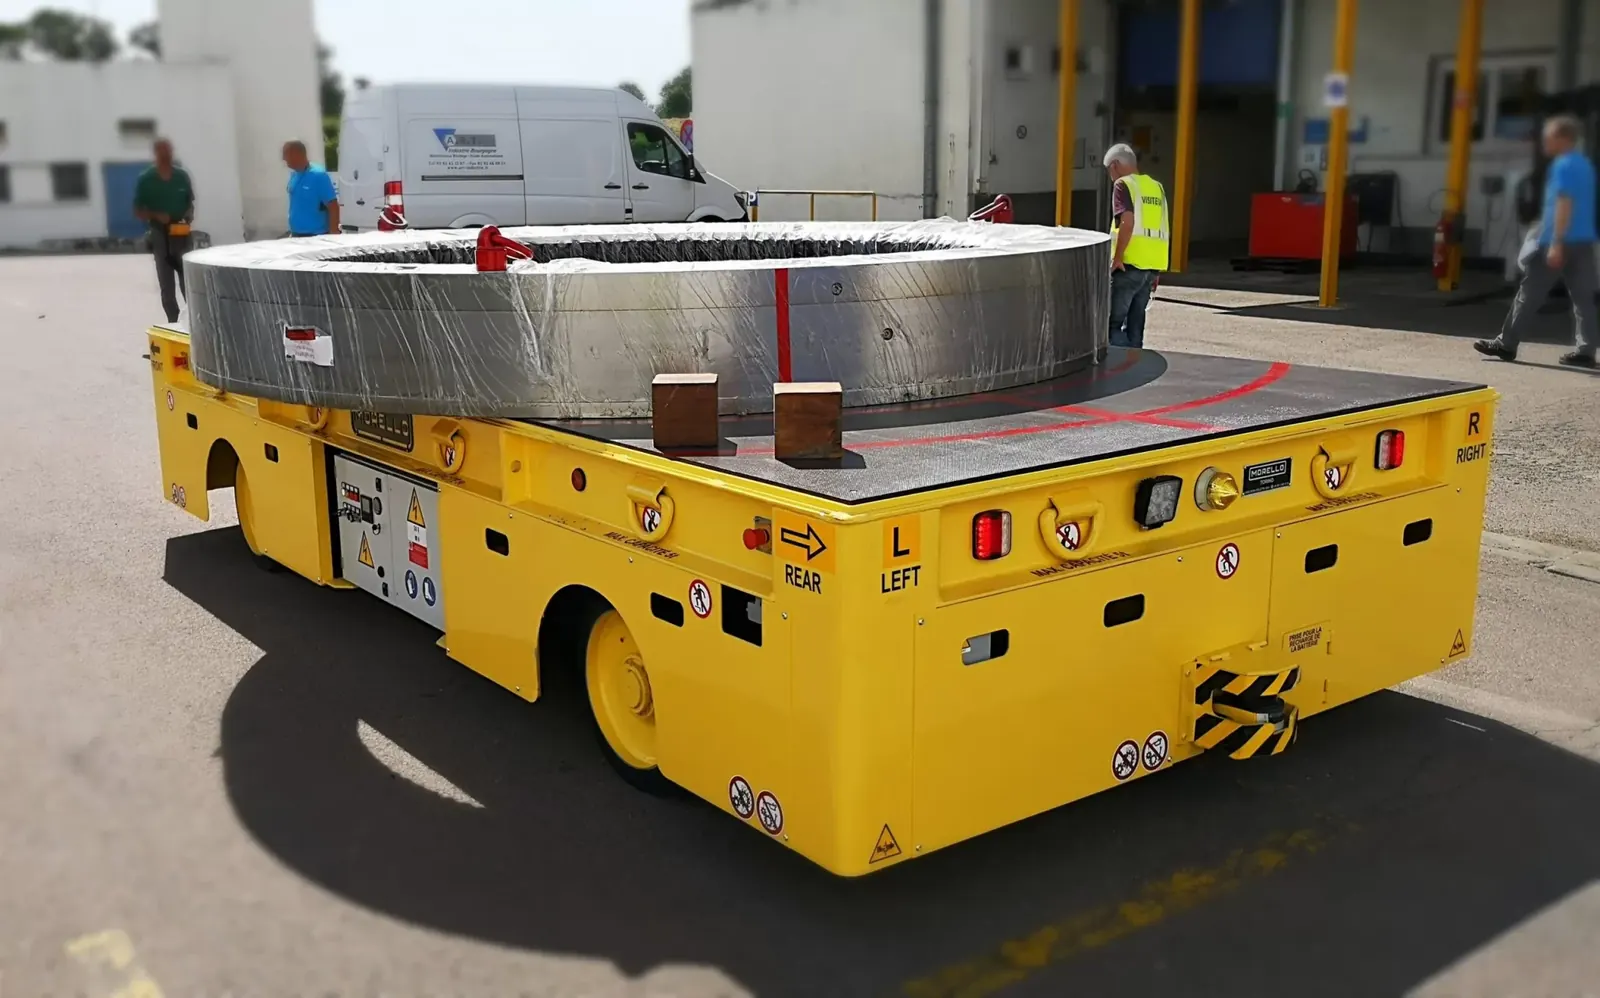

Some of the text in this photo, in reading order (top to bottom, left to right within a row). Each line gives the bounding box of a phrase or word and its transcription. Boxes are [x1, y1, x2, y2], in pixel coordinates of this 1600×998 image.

[1468, 411, 1480, 436] R
[1456, 442, 1487, 464] RIGHT
[1250, 464, 1285, 478] MORELLO
[893, 526, 910, 557] L
[785, 563, 821, 595] REAR
[881, 565, 921, 593] LEFT
